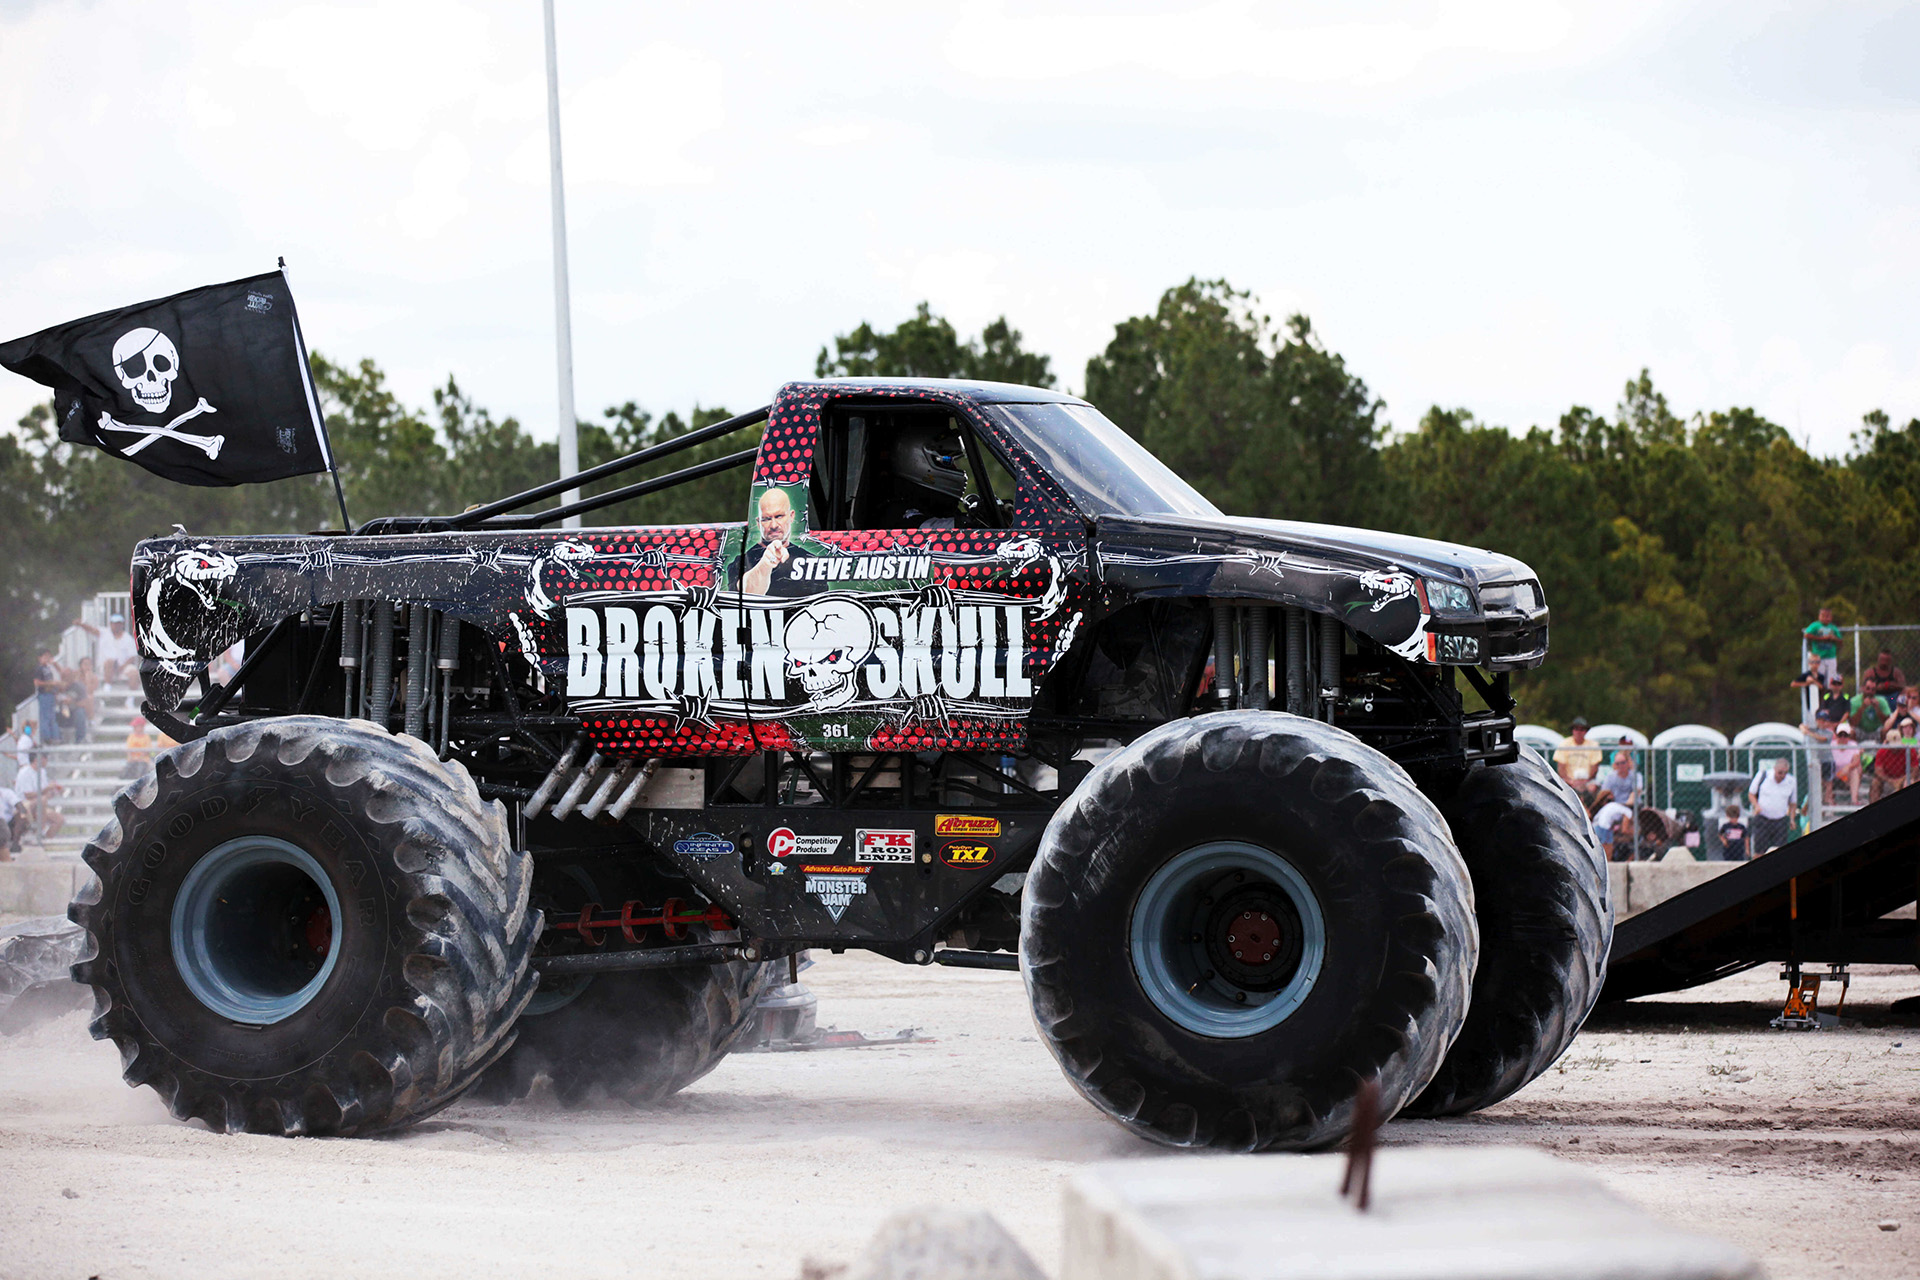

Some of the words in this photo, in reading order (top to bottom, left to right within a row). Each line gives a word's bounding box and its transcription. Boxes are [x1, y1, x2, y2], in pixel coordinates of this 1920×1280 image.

[790, 557, 852, 581] STEVE
[853, 555, 931, 580] AUSTIN
[565, 605, 785, 700] BROKEN
[866, 606, 1032, 699] SKULL
[822, 723, 849, 738] 361
[795, 837, 838, 845] Competition
[864, 833, 912, 847] FK
[127, 787, 377, 927] GOODYEAR
[871, 846, 912, 854] ROD
[952, 846, 989, 860] TX7
[859, 854, 912, 862] ENDS
[831, 865, 848, 873] Auto
[805, 880, 868, 894] MONSTER
[820, 893, 852, 906] JAM
